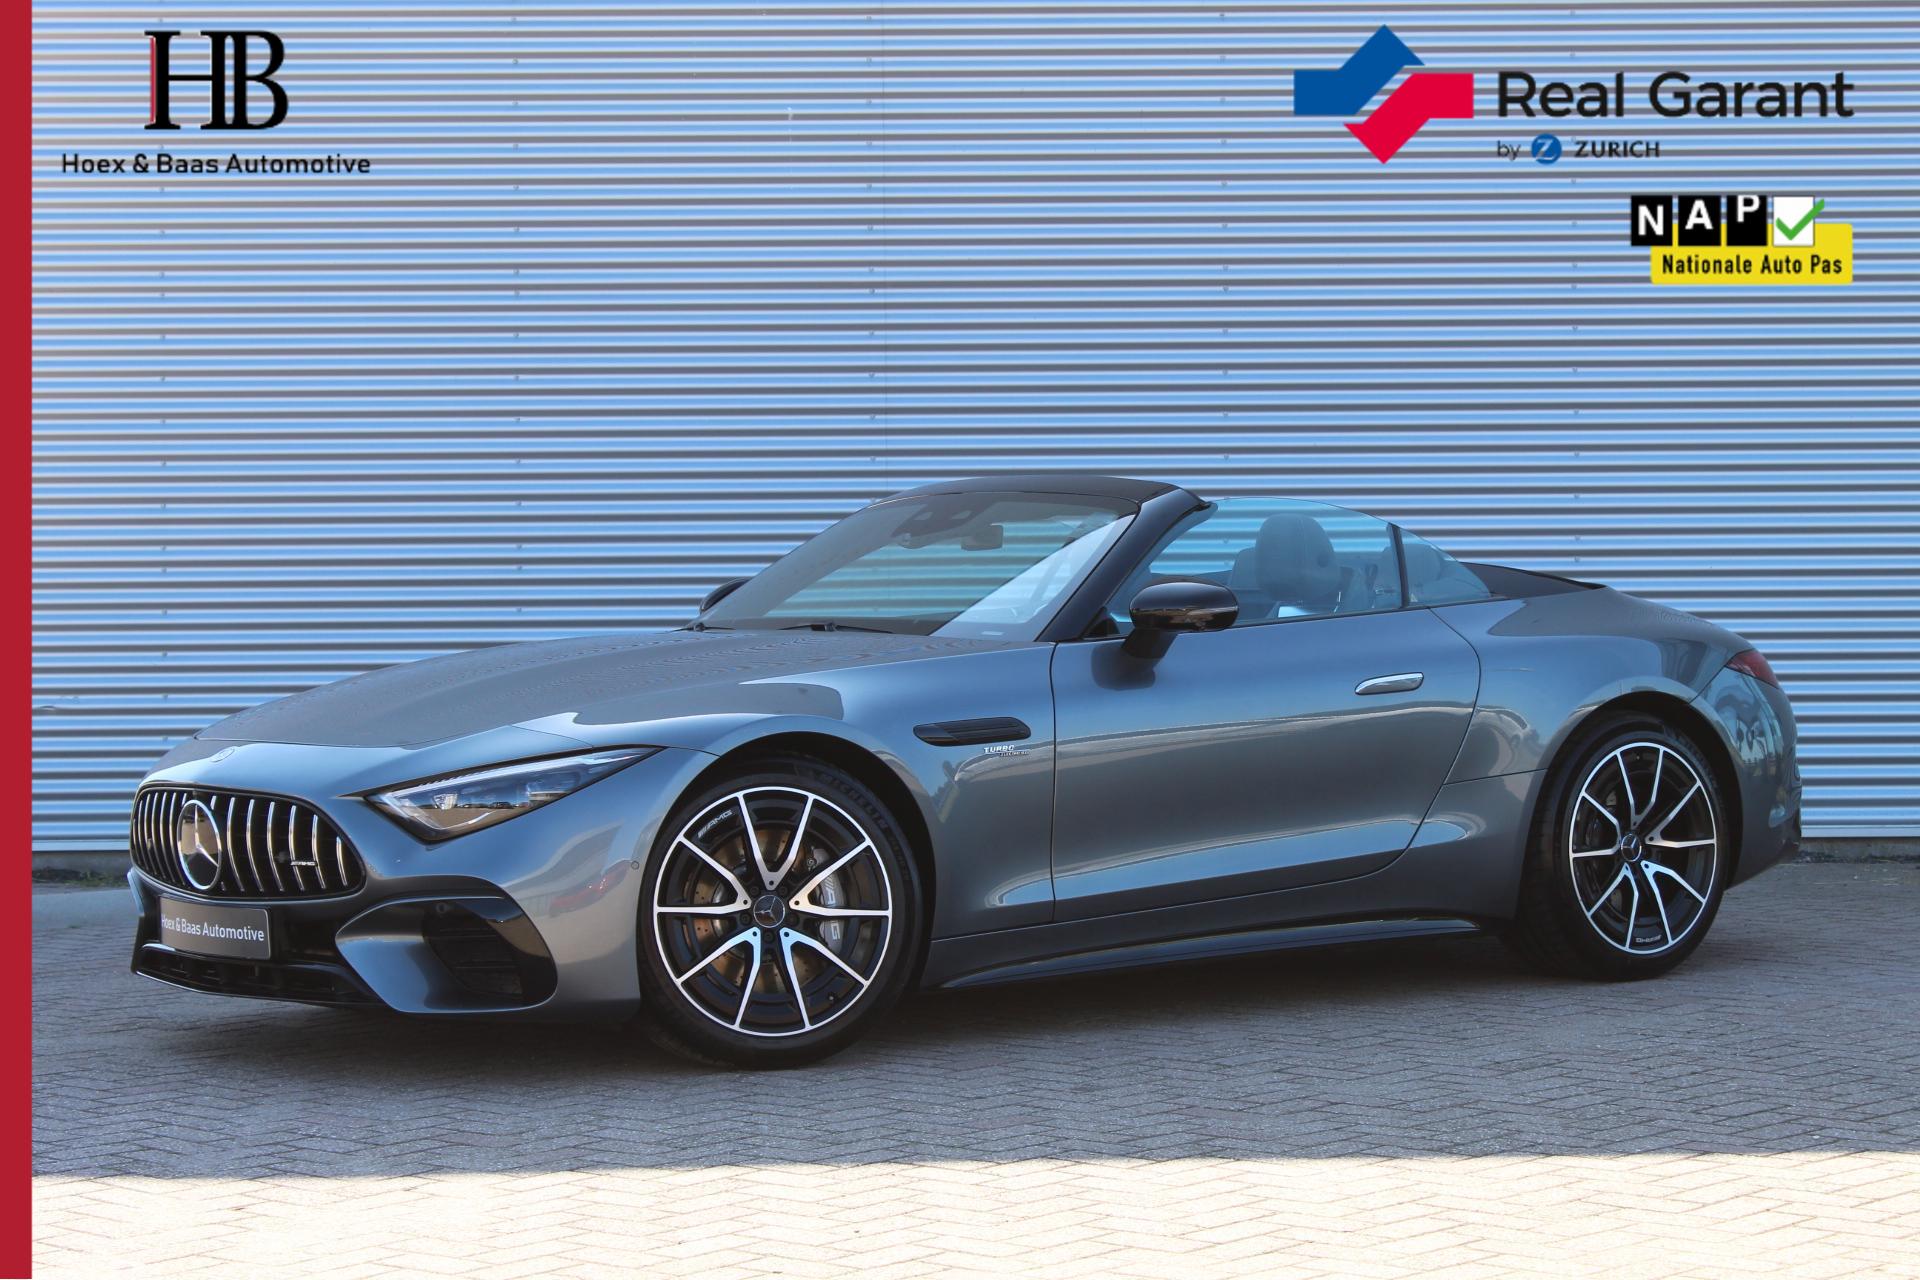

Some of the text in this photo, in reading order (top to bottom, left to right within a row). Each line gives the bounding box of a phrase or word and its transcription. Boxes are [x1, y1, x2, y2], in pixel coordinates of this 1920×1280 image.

[983, 744, 1015, 753] TURBO
[161, 914, 265, 941] Hoex & Baas Automotive
